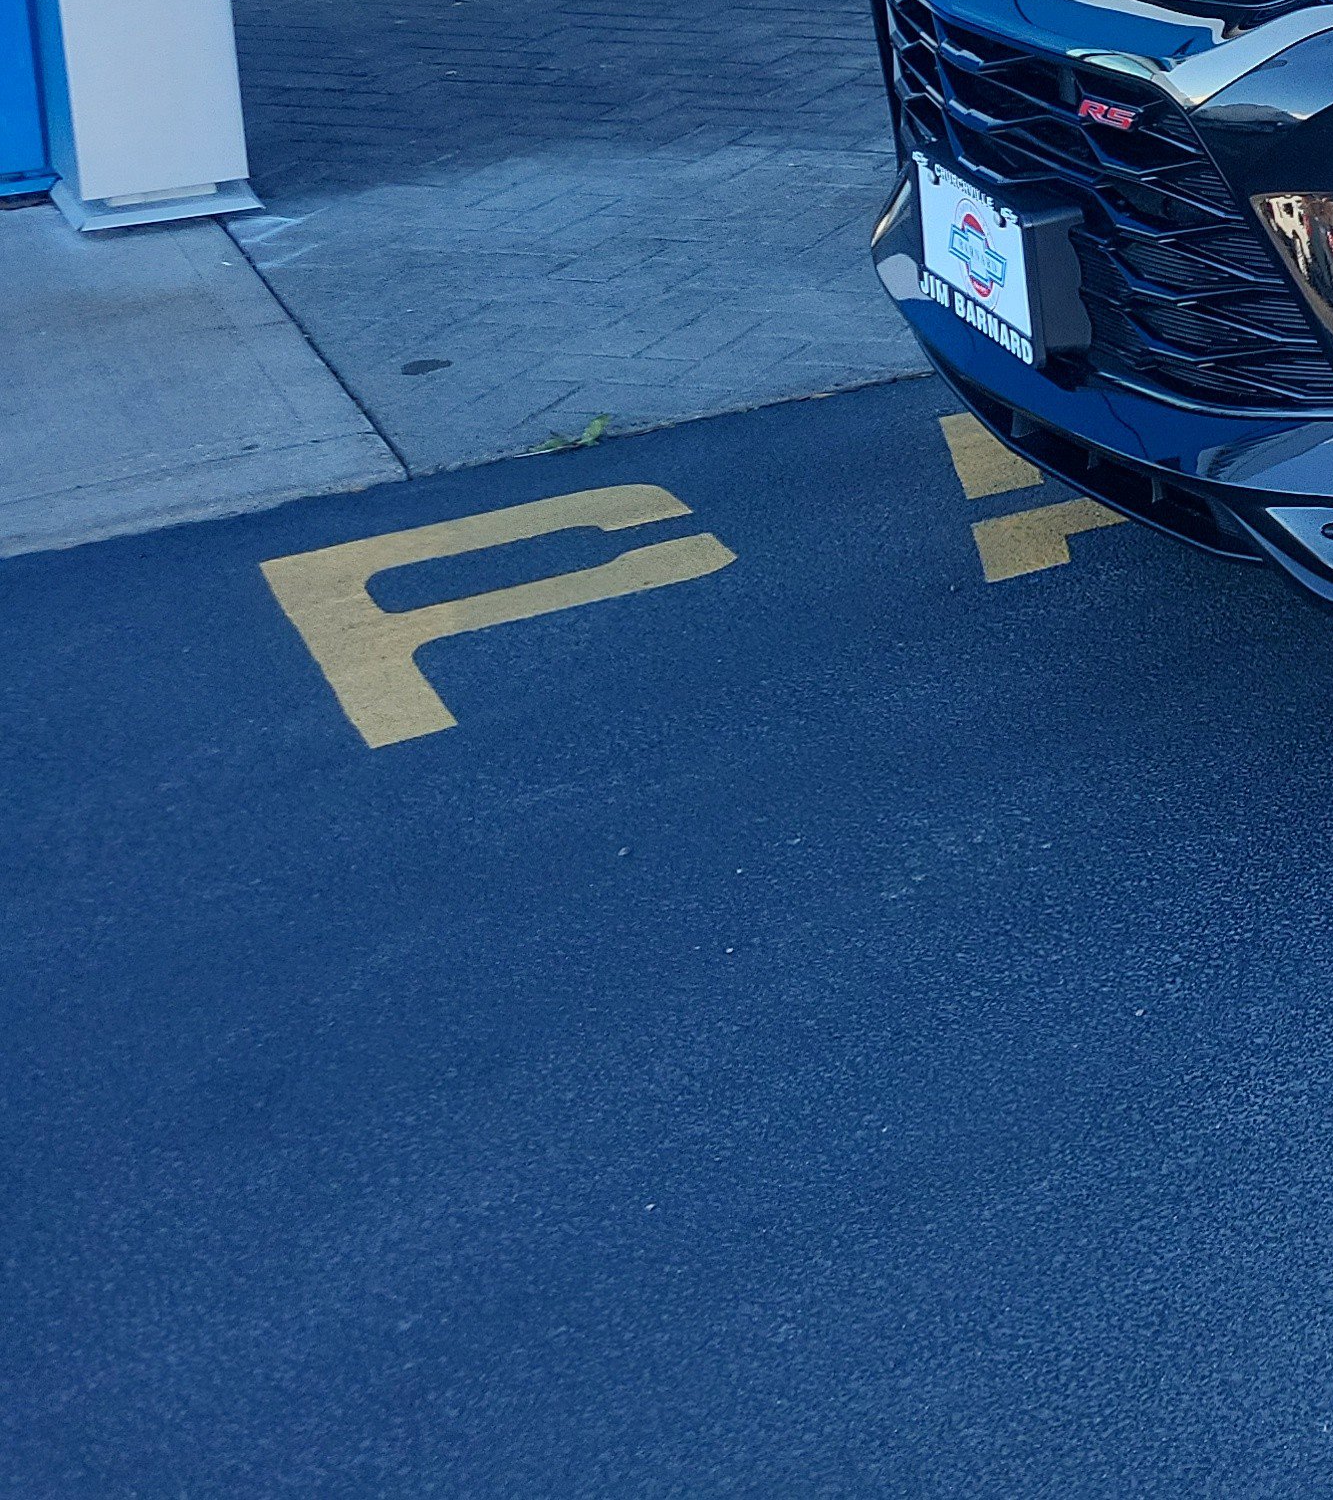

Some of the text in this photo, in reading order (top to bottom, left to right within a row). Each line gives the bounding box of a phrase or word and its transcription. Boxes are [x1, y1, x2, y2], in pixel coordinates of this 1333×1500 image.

[1078, 99, 1136, 130] RS
[934, 164, 995, 211] CHURCHVILLE
[920, 271, 1034, 365] JIM BARNARD
